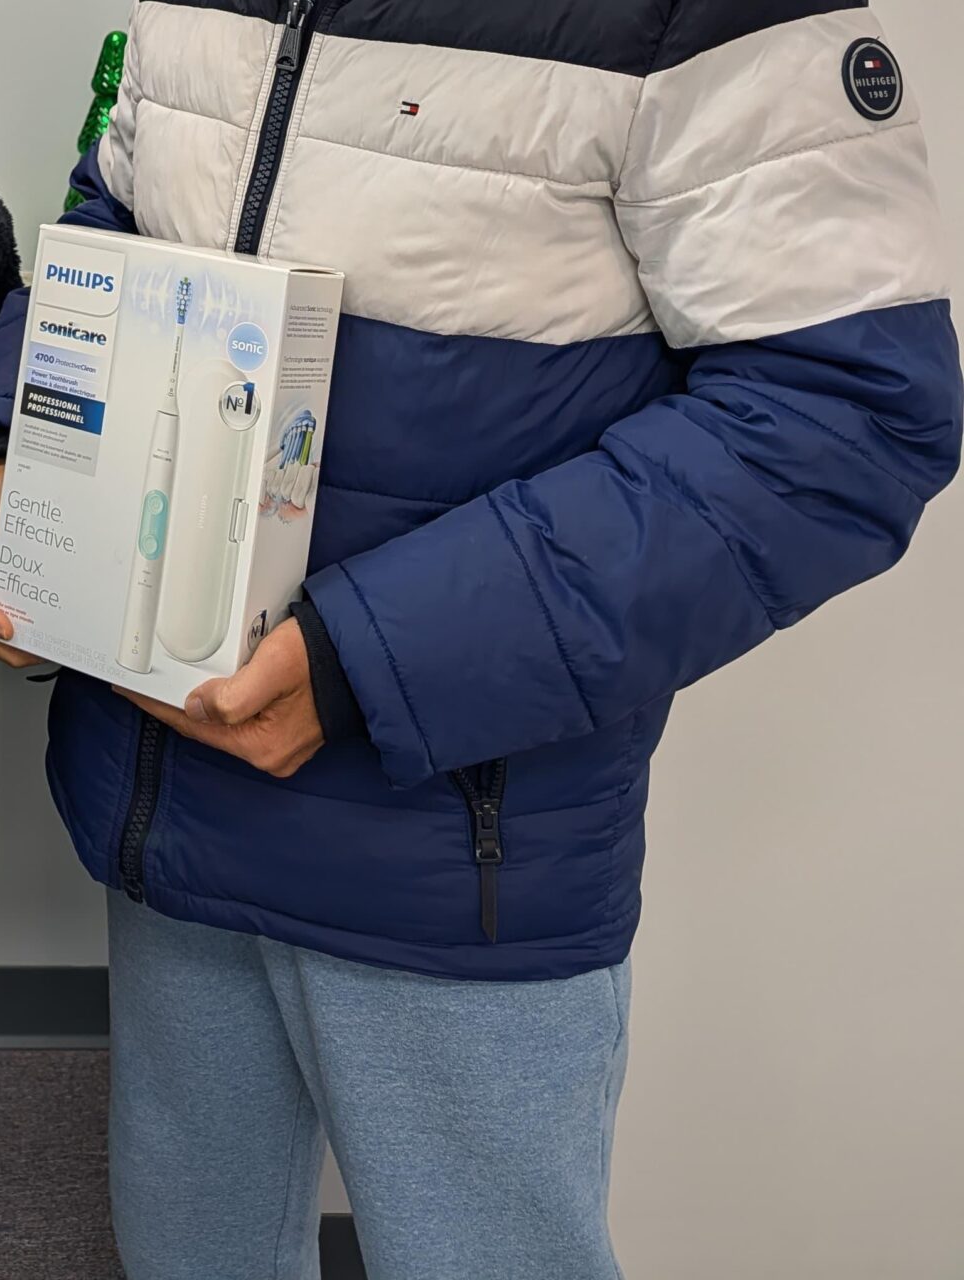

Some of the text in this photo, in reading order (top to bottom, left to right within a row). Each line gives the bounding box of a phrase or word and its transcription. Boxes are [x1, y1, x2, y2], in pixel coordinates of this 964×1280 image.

[855, 76, 897, 88] HILFIGER
[868, 90, 889, 99] 1985
[46, 264, 114, 293] PHILIPS
[39, 320, 107, 346] sonicare
[231, 339, 264, 355] sonic
[34, 352, 97, 374] 4700 ProtectiveClean
[30, 377, 48, 387] Brosse
[53, 382, 68, 392] dents
[31, 370, 78, 387] Power Toothbrush
[27, 402, 84, 424] PROFESSIONNEL
[28, 392, 81, 413] PROFESSIONAL
[7, 490, 64, 524] Gentle.
[4, 513, 76, 554] Effective.
[0, 545, 45, 578] Doux.
